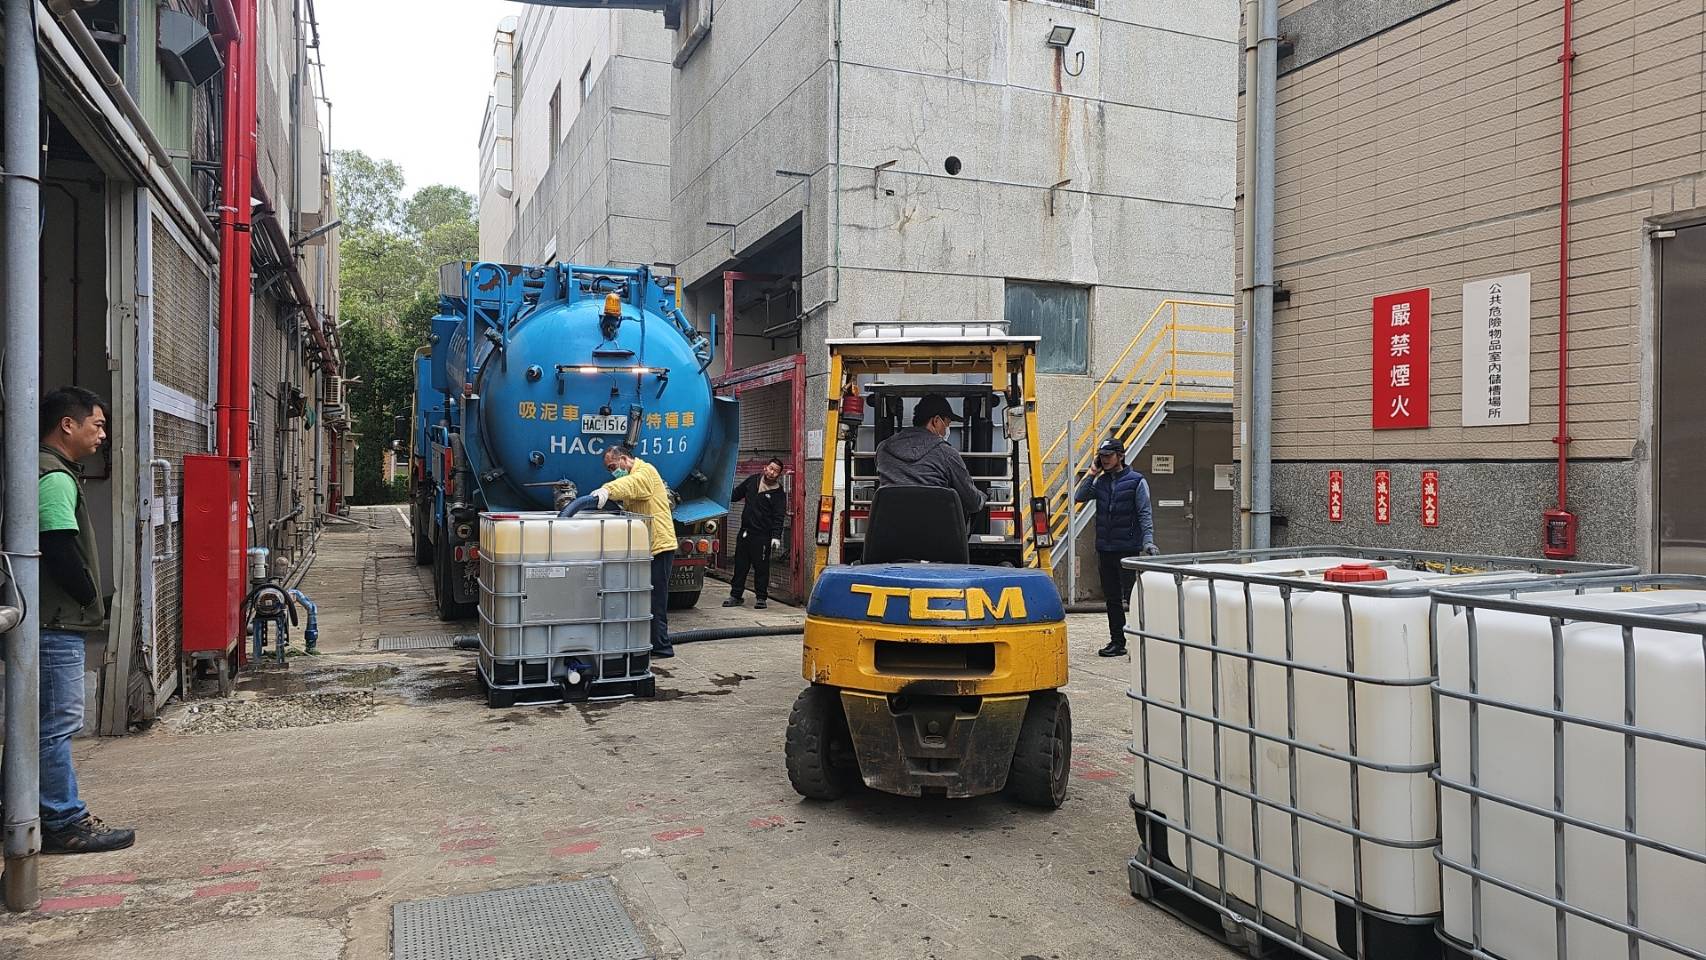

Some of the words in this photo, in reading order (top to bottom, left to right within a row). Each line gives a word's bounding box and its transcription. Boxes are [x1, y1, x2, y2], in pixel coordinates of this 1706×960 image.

[1389, 302, 1411, 418] 嚴禁煙火
[1488, 282, 1502, 419] 公共危險物品室內儲槽場所
[518, 401, 580, 422] 吸泥車
[645, 411, 696, 430] 特種車
[582, 418, 627, 432] HAC-1516
[550, 435, 604, 456] HAC
[640, 435, 688, 456] 1516
[850, 583, 1028, 621] TCM
